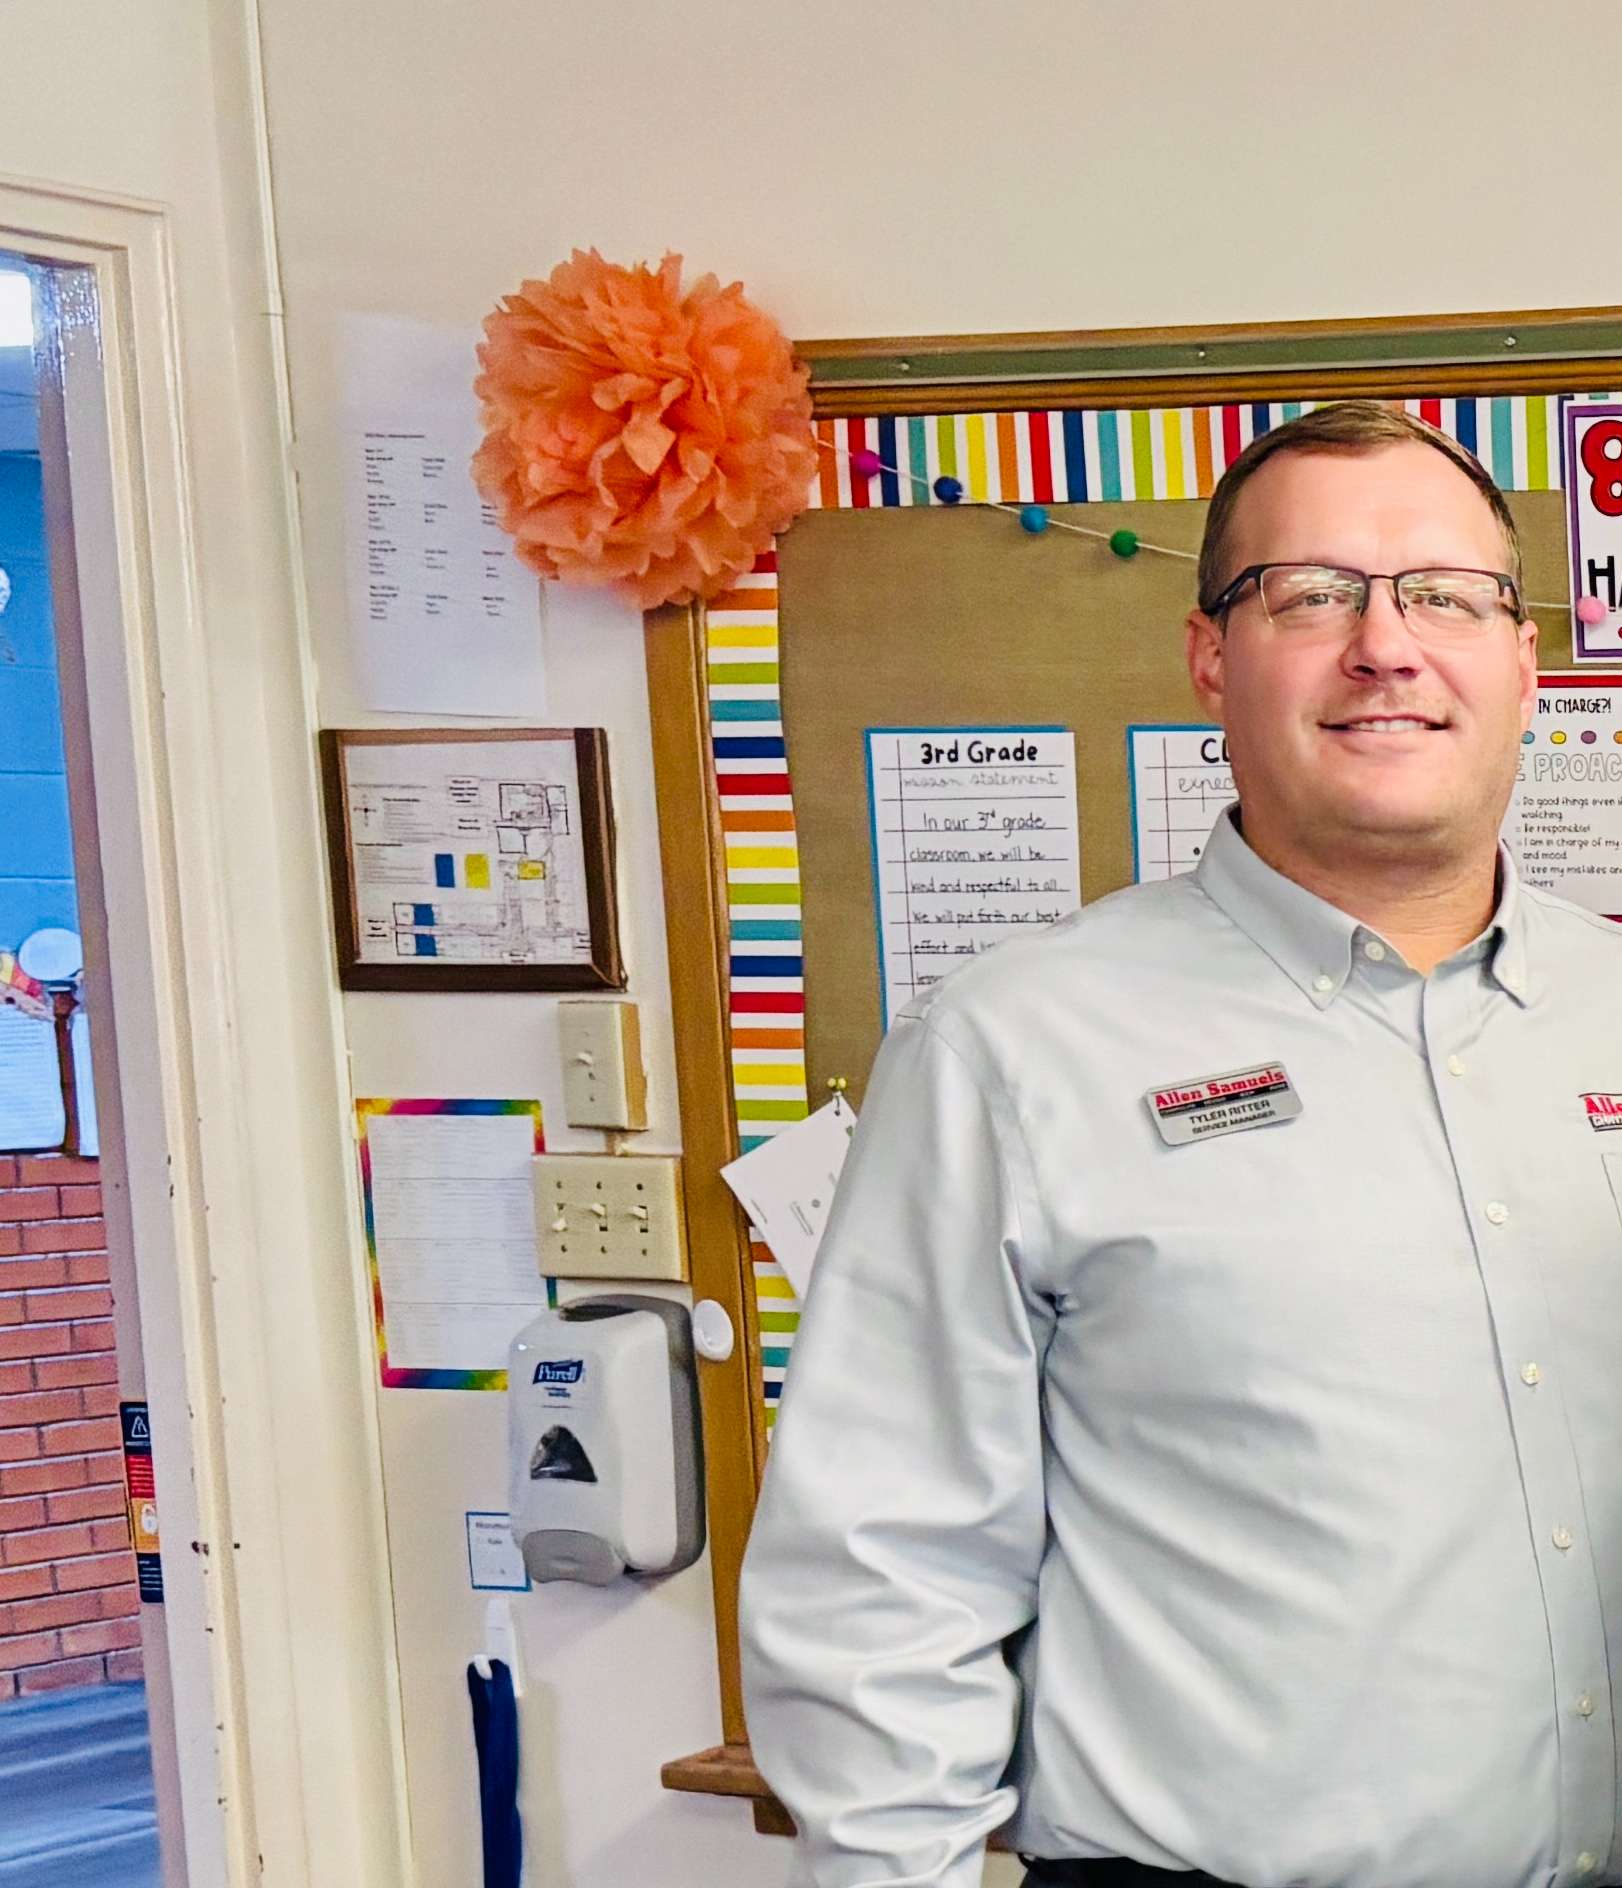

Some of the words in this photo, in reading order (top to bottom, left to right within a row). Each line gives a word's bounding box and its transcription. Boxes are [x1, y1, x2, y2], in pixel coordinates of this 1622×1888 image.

[1538, 699, 1550, 714] IN
[920, 739, 959, 764] 3rd
[968, 738, 1038, 764] Grade
[1154, 1089, 1203, 1108] Allen
[1206, 1071, 1285, 1096] Samuels
[1189, 1108, 1227, 1124] TYLER
[538, 1363, 577, 1382] Purell
